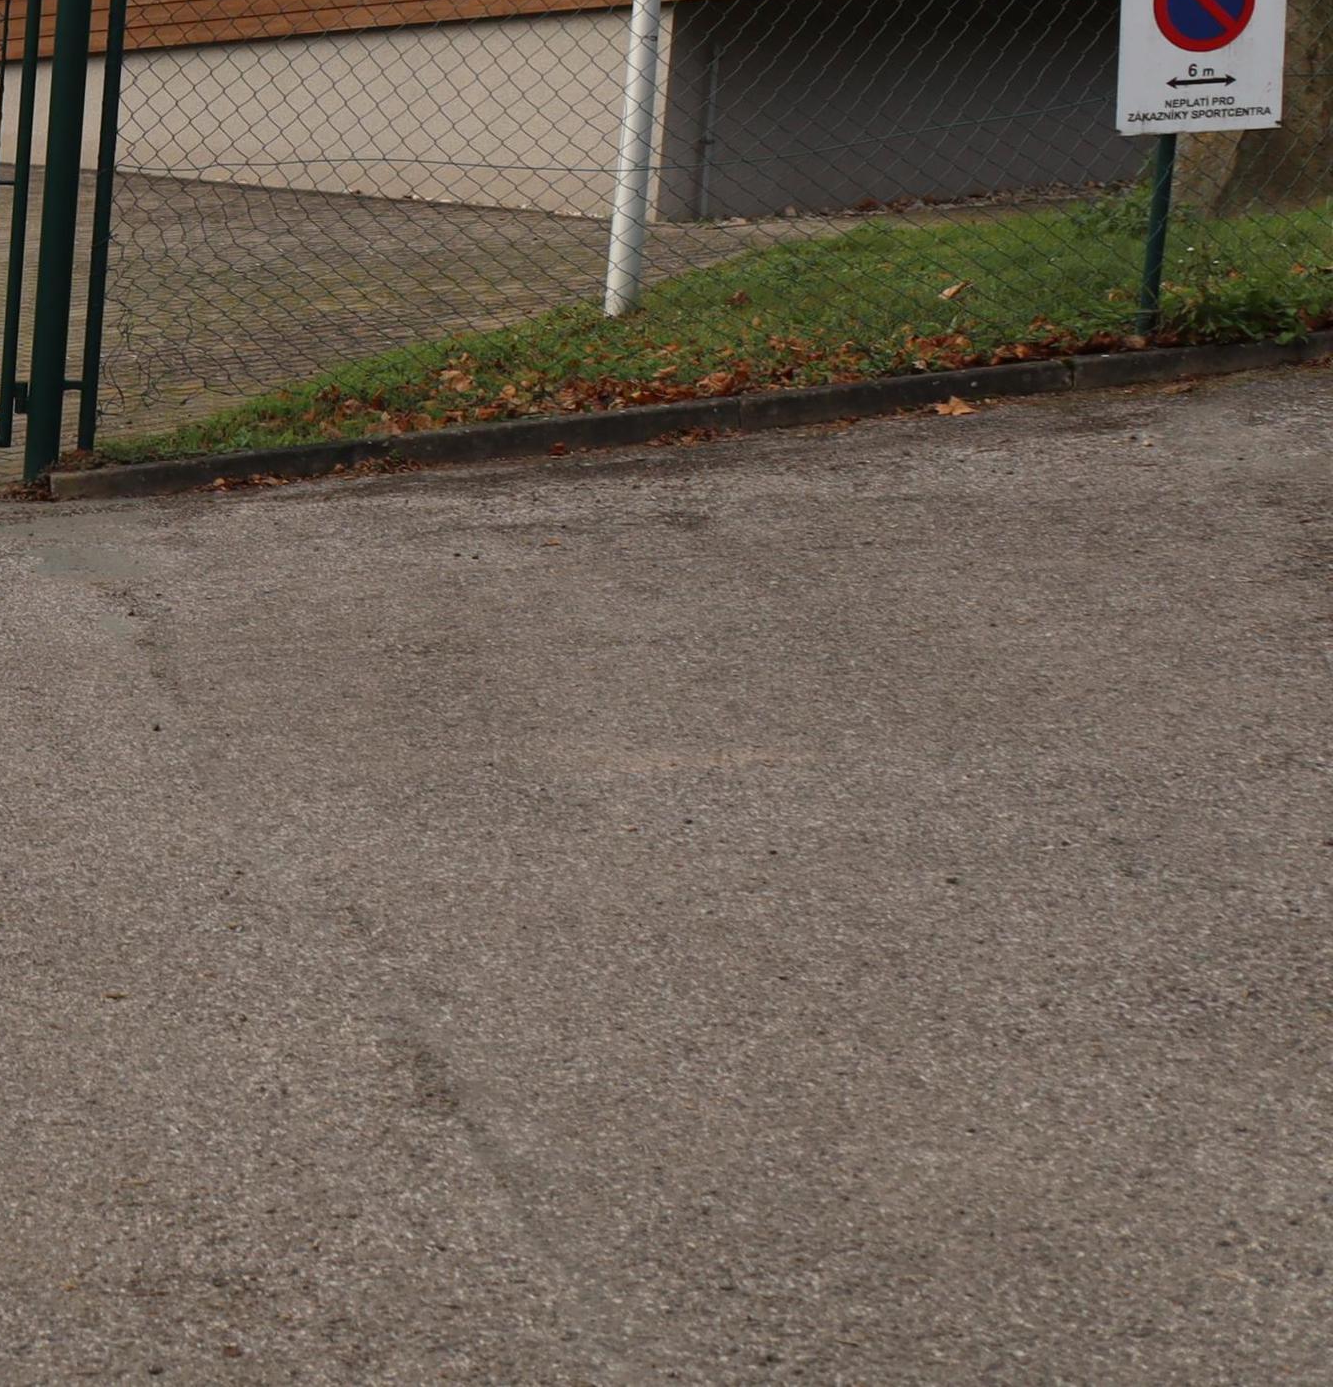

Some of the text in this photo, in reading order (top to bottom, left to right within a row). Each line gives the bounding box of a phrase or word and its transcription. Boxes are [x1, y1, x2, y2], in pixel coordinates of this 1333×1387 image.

[1188, 63, 1215, 77] 6 m
[1164, 95, 1235, 108] NEPLATÍ PRO
[1127, 106, 1272, 122] ZÁKAZNÍKY SPORTCENTRA
